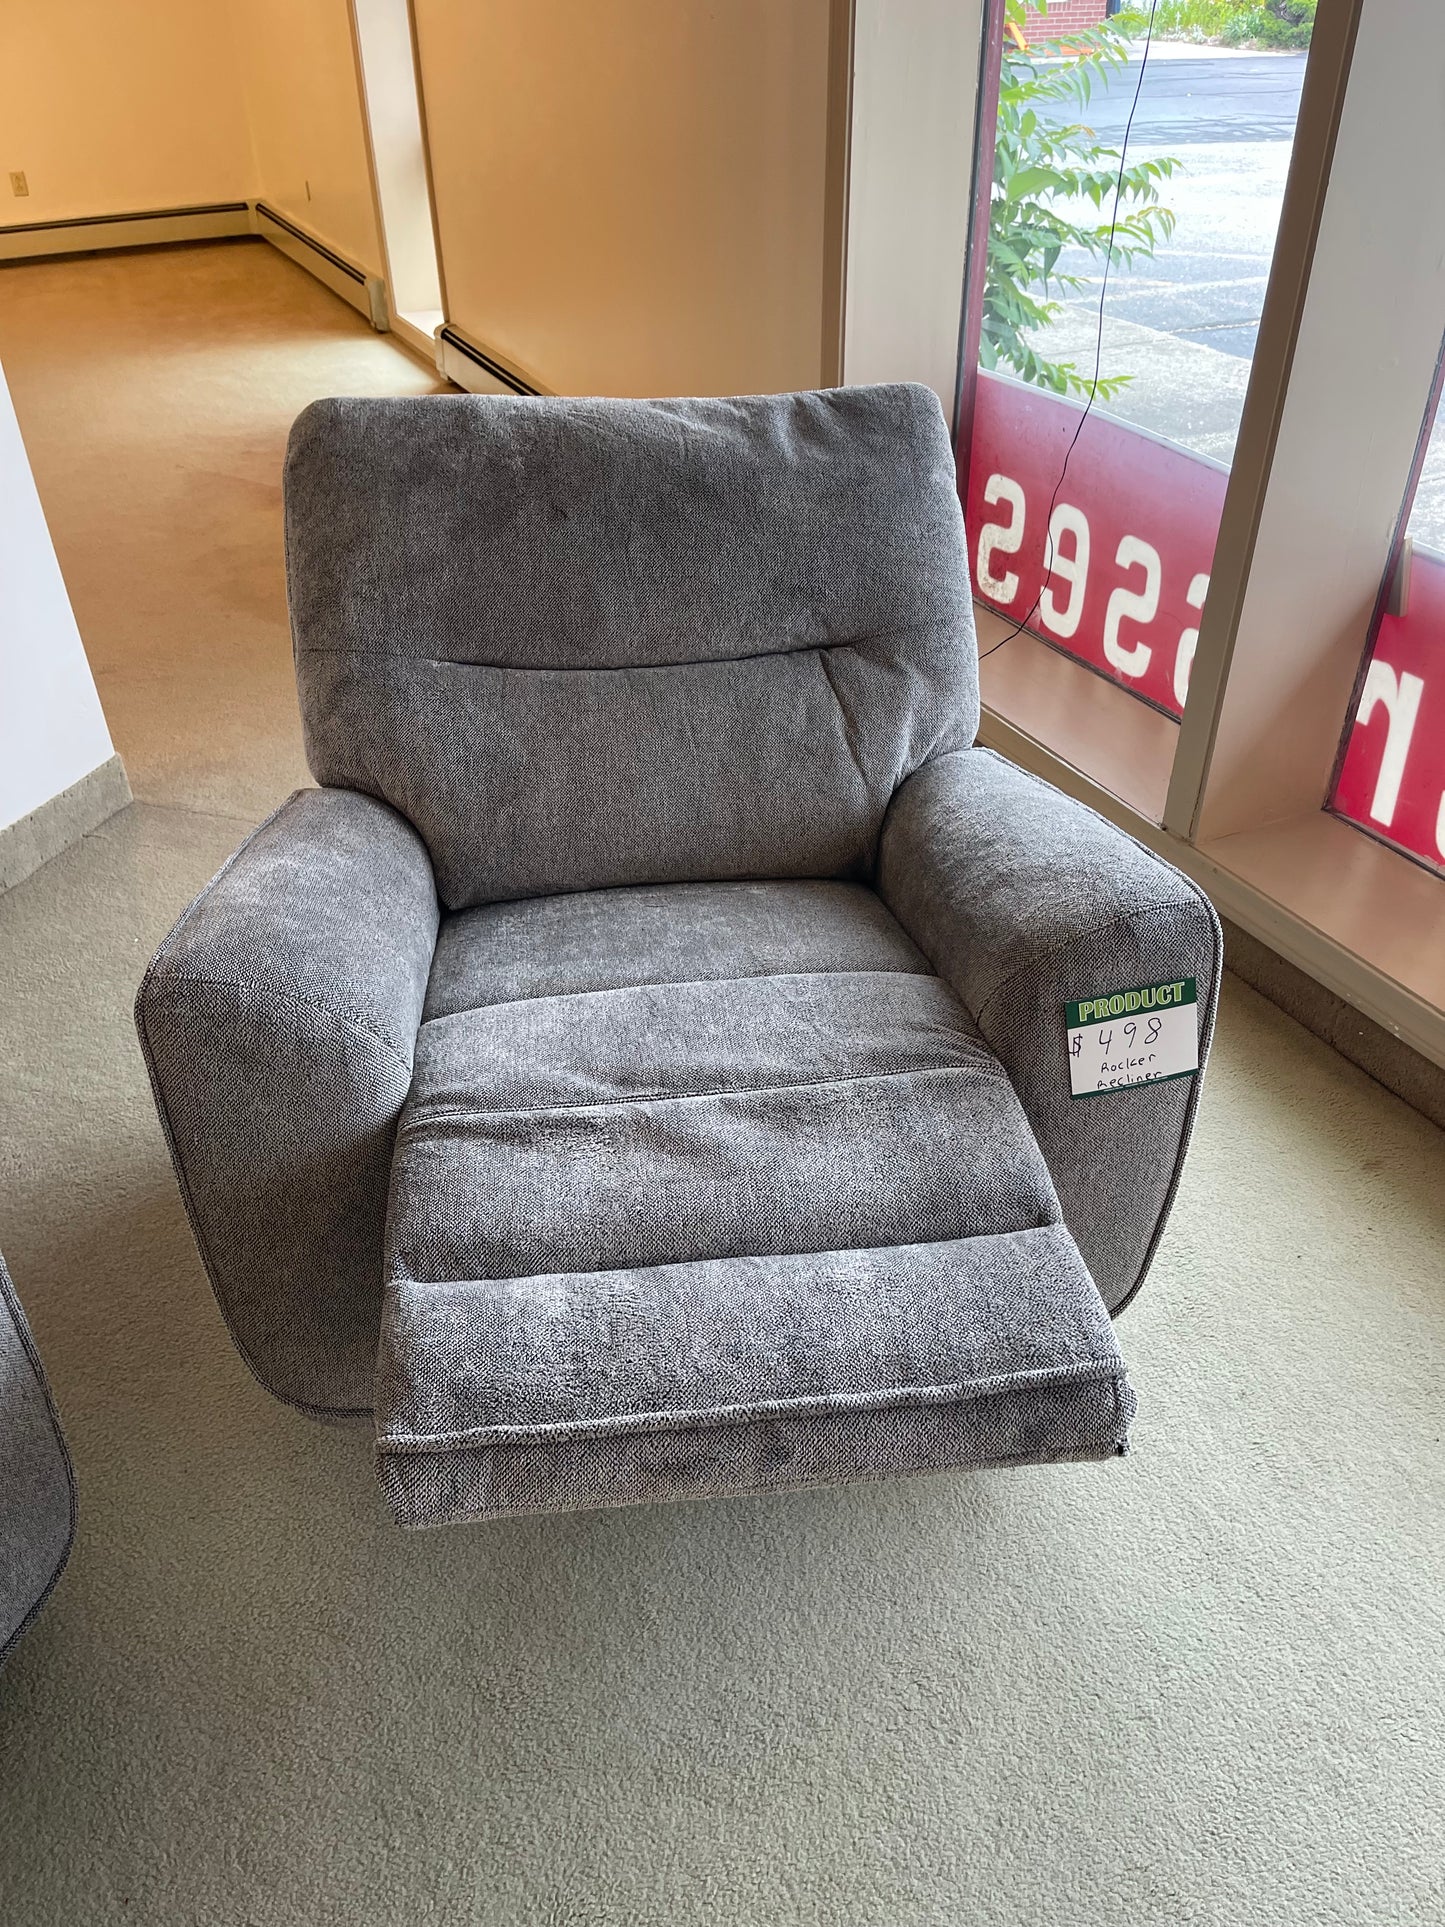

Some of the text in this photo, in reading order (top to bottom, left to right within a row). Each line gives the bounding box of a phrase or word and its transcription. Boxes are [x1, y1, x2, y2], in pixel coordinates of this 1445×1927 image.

[1078, 981, 1185, 1022] PRODUCT
[1068, 1017, 1162, 1058] $ 498
[1101, 1053, 1156, 1073] Rocker
[1097, 1070, 1162, 1090] Recliner
